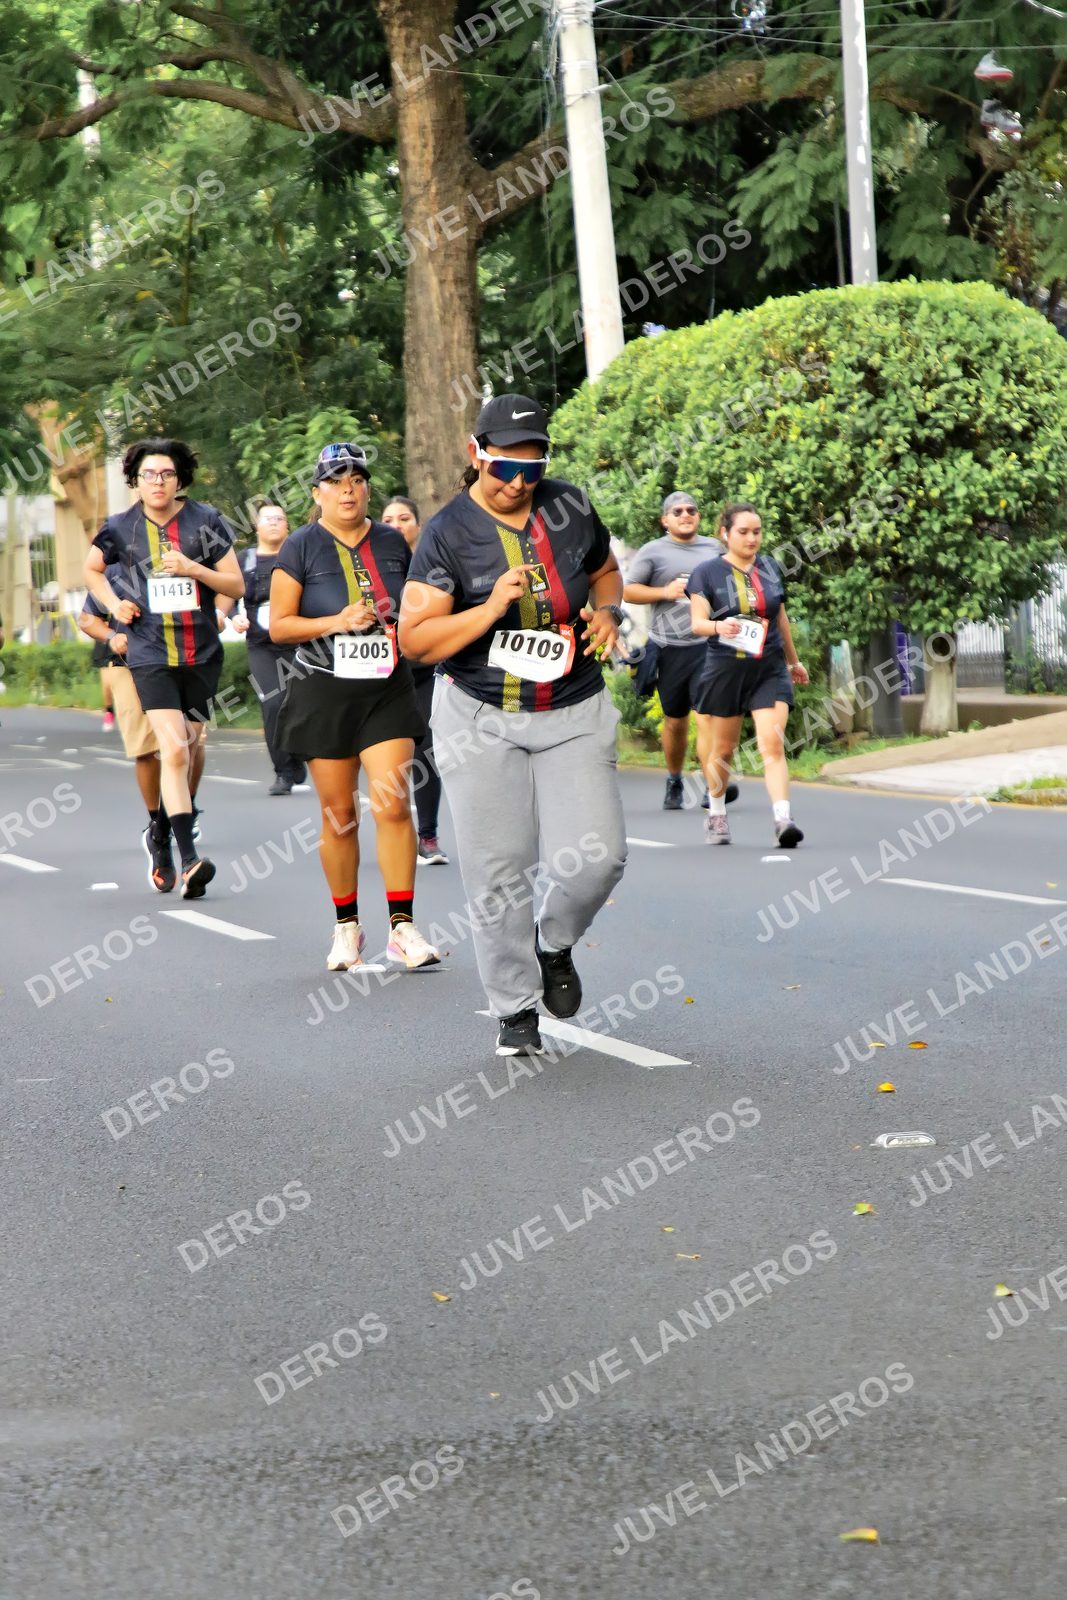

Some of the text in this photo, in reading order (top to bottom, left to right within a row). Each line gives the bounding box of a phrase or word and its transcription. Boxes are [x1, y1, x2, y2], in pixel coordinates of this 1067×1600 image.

[152, 581, 193, 597] 11413
[338, 641, 389, 659] 12005
[499, 630, 565, 661] 10109
